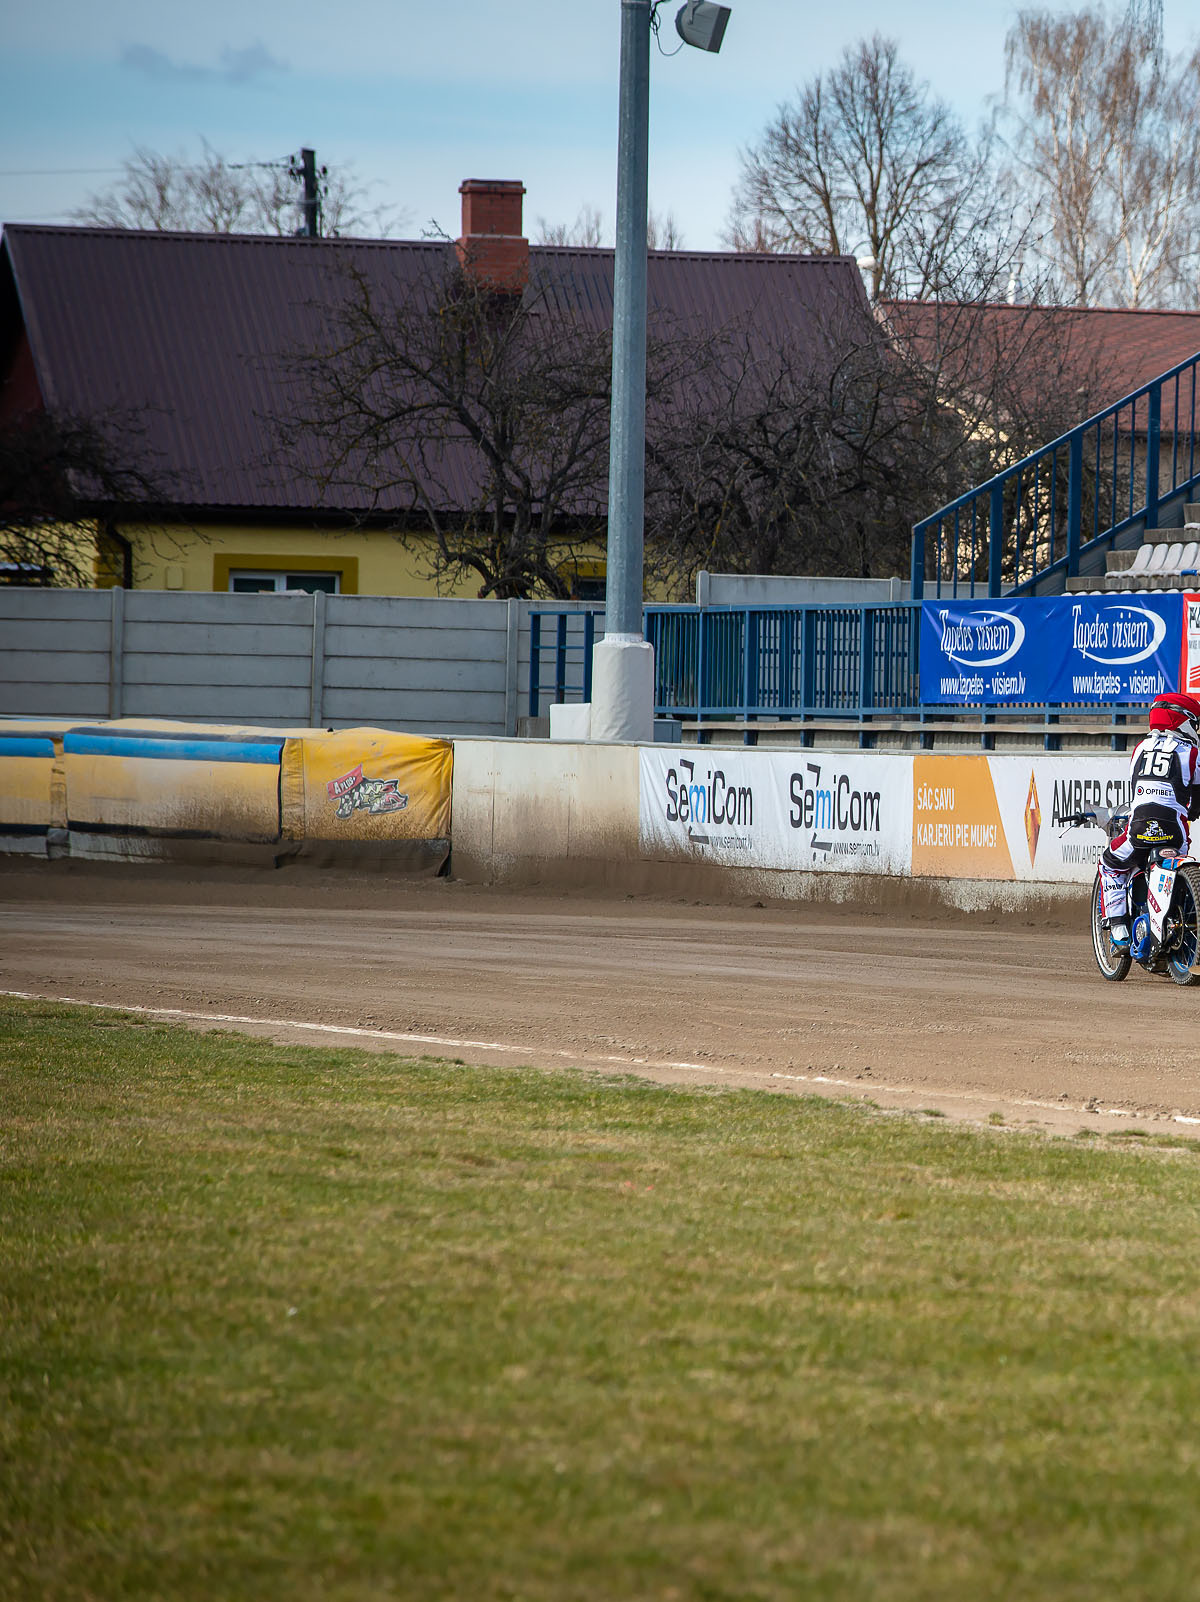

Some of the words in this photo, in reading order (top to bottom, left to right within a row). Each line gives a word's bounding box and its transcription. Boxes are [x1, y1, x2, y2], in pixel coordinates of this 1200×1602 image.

[939, 609, 973, 661] Tapetes
[977, 615, 1010, 651] visiem
[1072, 604, 1109, 659] Tapetes
[1112, 612, 1149, 648] visiem
[1139, 751, 1173, 778] 15
[666, 768, 753, 826] SemiCom
[789, 772, 881, 832] SemiCom
[917, 782, 933, 811] SĀC
[934, 787, 955, 811] SAVU
[917, 823, 954, 847] KARJERU
[955, 823, 969, 847] PIE
[970, 824, 997, 848] MUMS!
